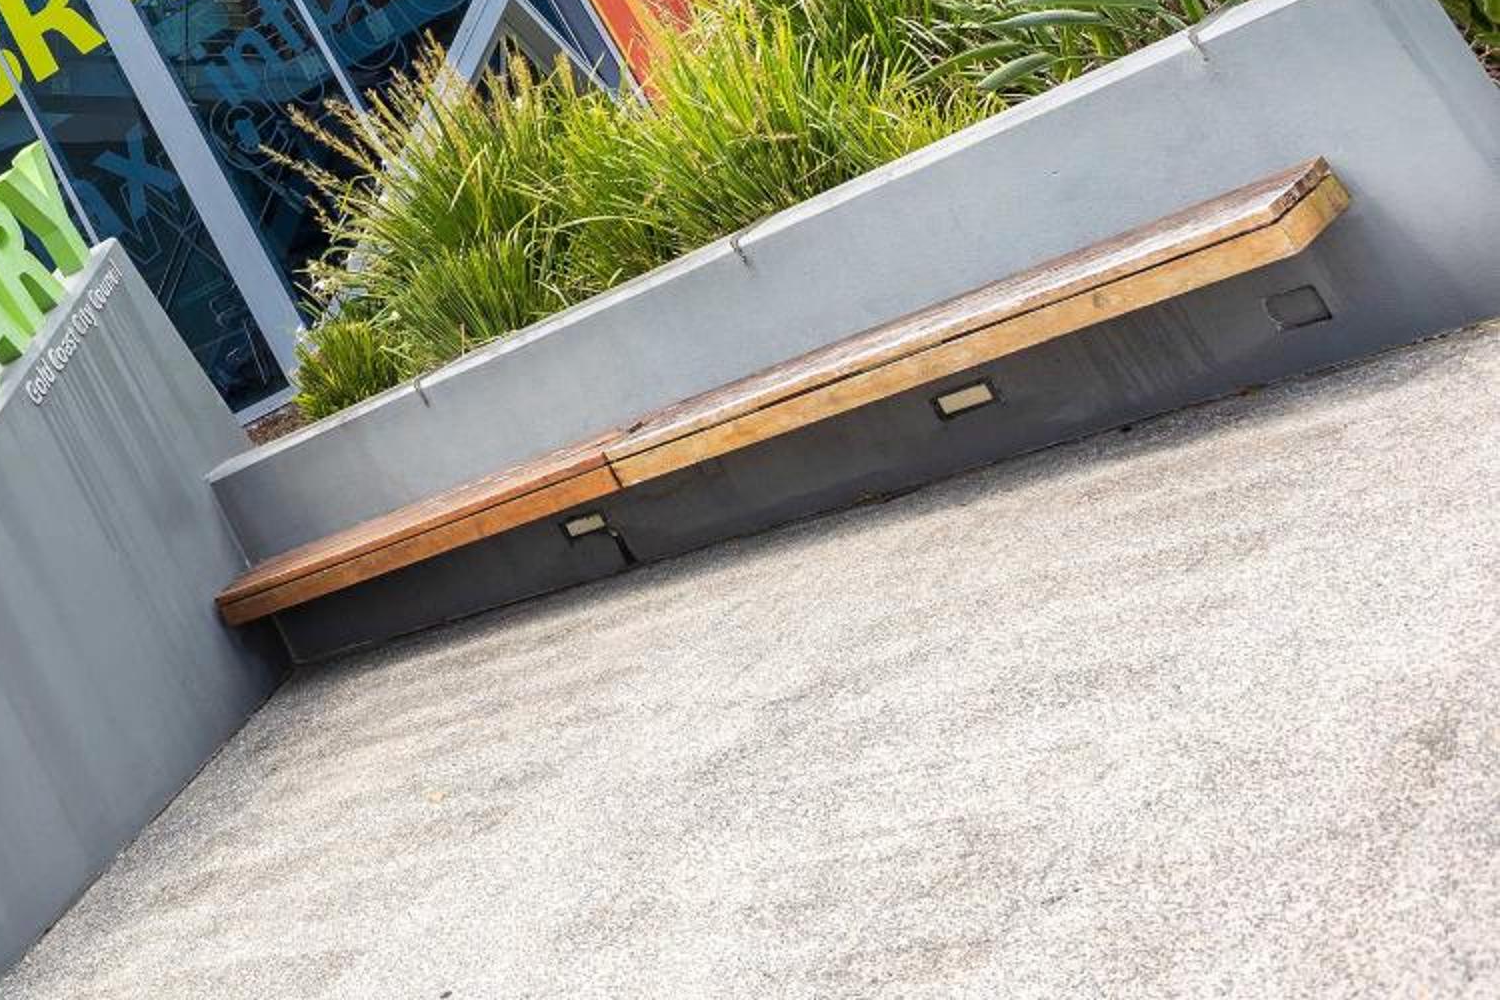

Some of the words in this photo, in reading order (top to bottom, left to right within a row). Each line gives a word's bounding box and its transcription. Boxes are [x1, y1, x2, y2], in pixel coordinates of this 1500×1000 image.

[25, 357, 56, 406] Gold
[49, 328, 81, 372] Coast
[71, 303, 99, 336] City
[88, 258, 124, 310] Council
